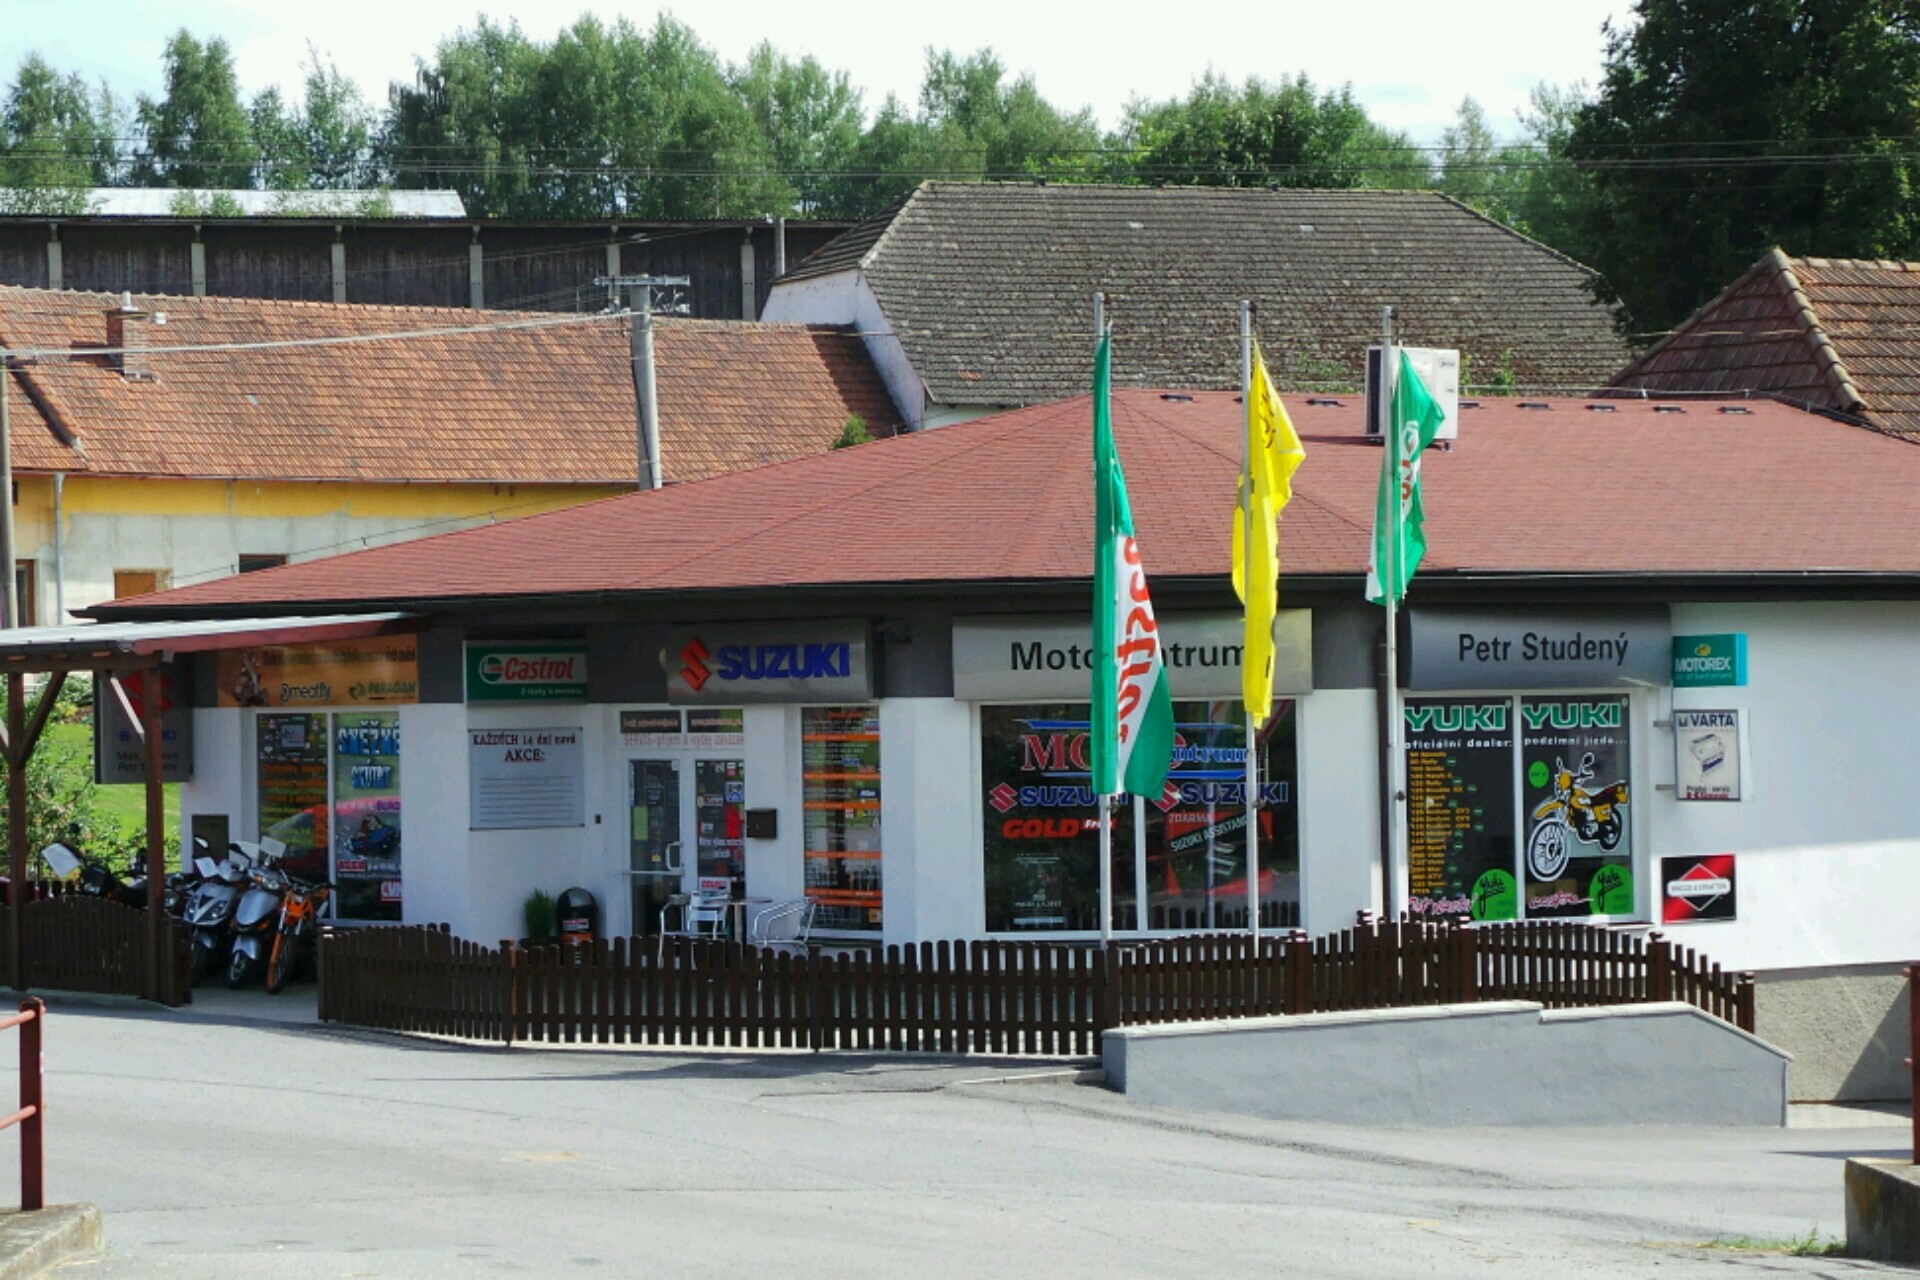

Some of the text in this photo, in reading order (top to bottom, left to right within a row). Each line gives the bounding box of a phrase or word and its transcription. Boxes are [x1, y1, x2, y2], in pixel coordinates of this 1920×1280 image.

[717, 643, 850, 680] SUZUKI
[1459, 632, 1629, 666] Petr Studený
[504, 656, 574, 681] Castrol
[1675, 656, 1731, 672] MOTOREX
[1404, 705, 1505, 732] YUKI
[1522, 703, 1621, 730] YUKI
[1691, 714, 1734, 727] VARTA
[504, 748, 546, 762] AKCE:
[1003, 819, 1080, 838] GOLD
